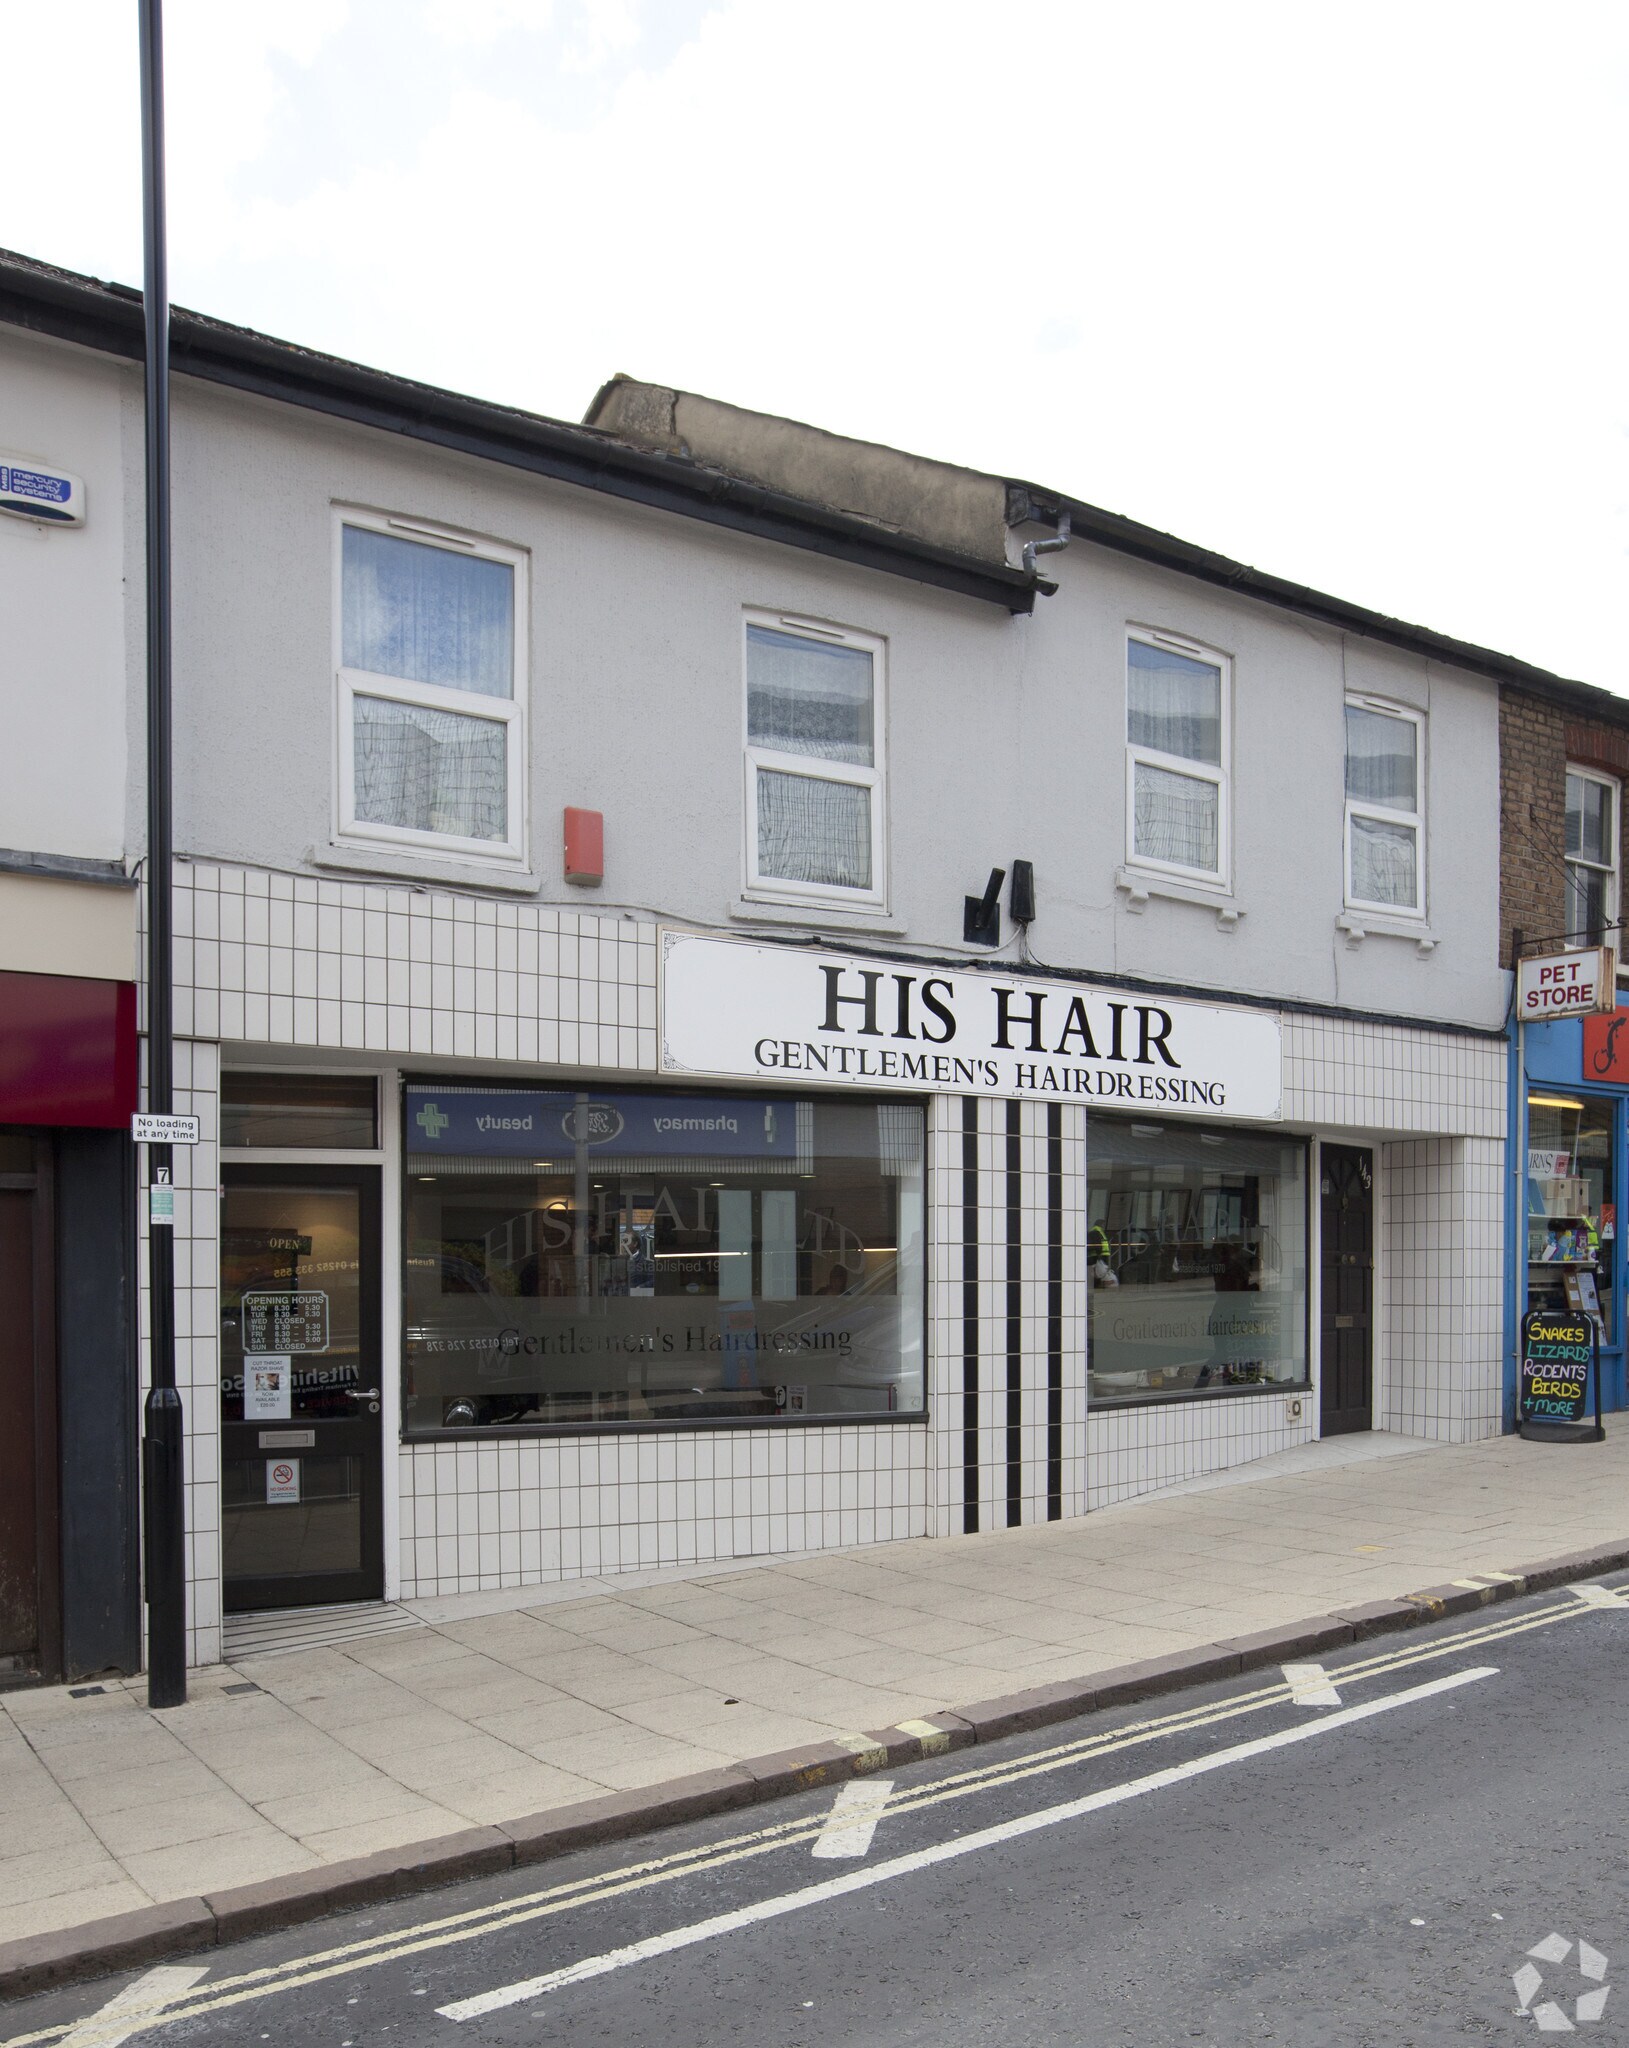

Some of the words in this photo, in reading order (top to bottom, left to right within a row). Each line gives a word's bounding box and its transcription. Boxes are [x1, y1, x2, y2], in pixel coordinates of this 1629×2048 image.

[14, 471, 61, 488] mercury
[14, 478, 60, 494] security
[14, 486, 63, 501] systems
[1540, 963, 1580, 985] PET
[1526, 984, 1593, 1007] STORE
[818, 964, 956, 1043] HIS
[991, 987, 1181, 1068] HAIR
[754, 1038, 999, 1087] GENTLEMEN'S
[1014, 1063, 1226, 1106] HAIRDRESSING
[137, 1129, 147, 1137] at
[151, 1130, 169, 1139] any
[172, 1130, 195, 1139] time
[138, 1118, 153, 1127] No
[156, 1118, 194, 1130] loading
[158, 1169, 168, 1183] 7
[269, 1237, 300, 1250] OPEN
[246, 1296, 289, 1305] OPENING
[291, 1296, 324, 1304] HOURS
[1113, 1316, 1197, 1341] Gentlemen's
[1528, 1322, 1585, 1342] SNAKES
[499, 1326, 674, 1356] Gentlemen's
[685, 1323, 853, 1356] Hairdressing
[1527, 1341, 1590, 1362] LIZARDS
[1524, 1358, 1586, 1380] RODENTS
[1531, 1378, 1581, 1398] BIRDS
